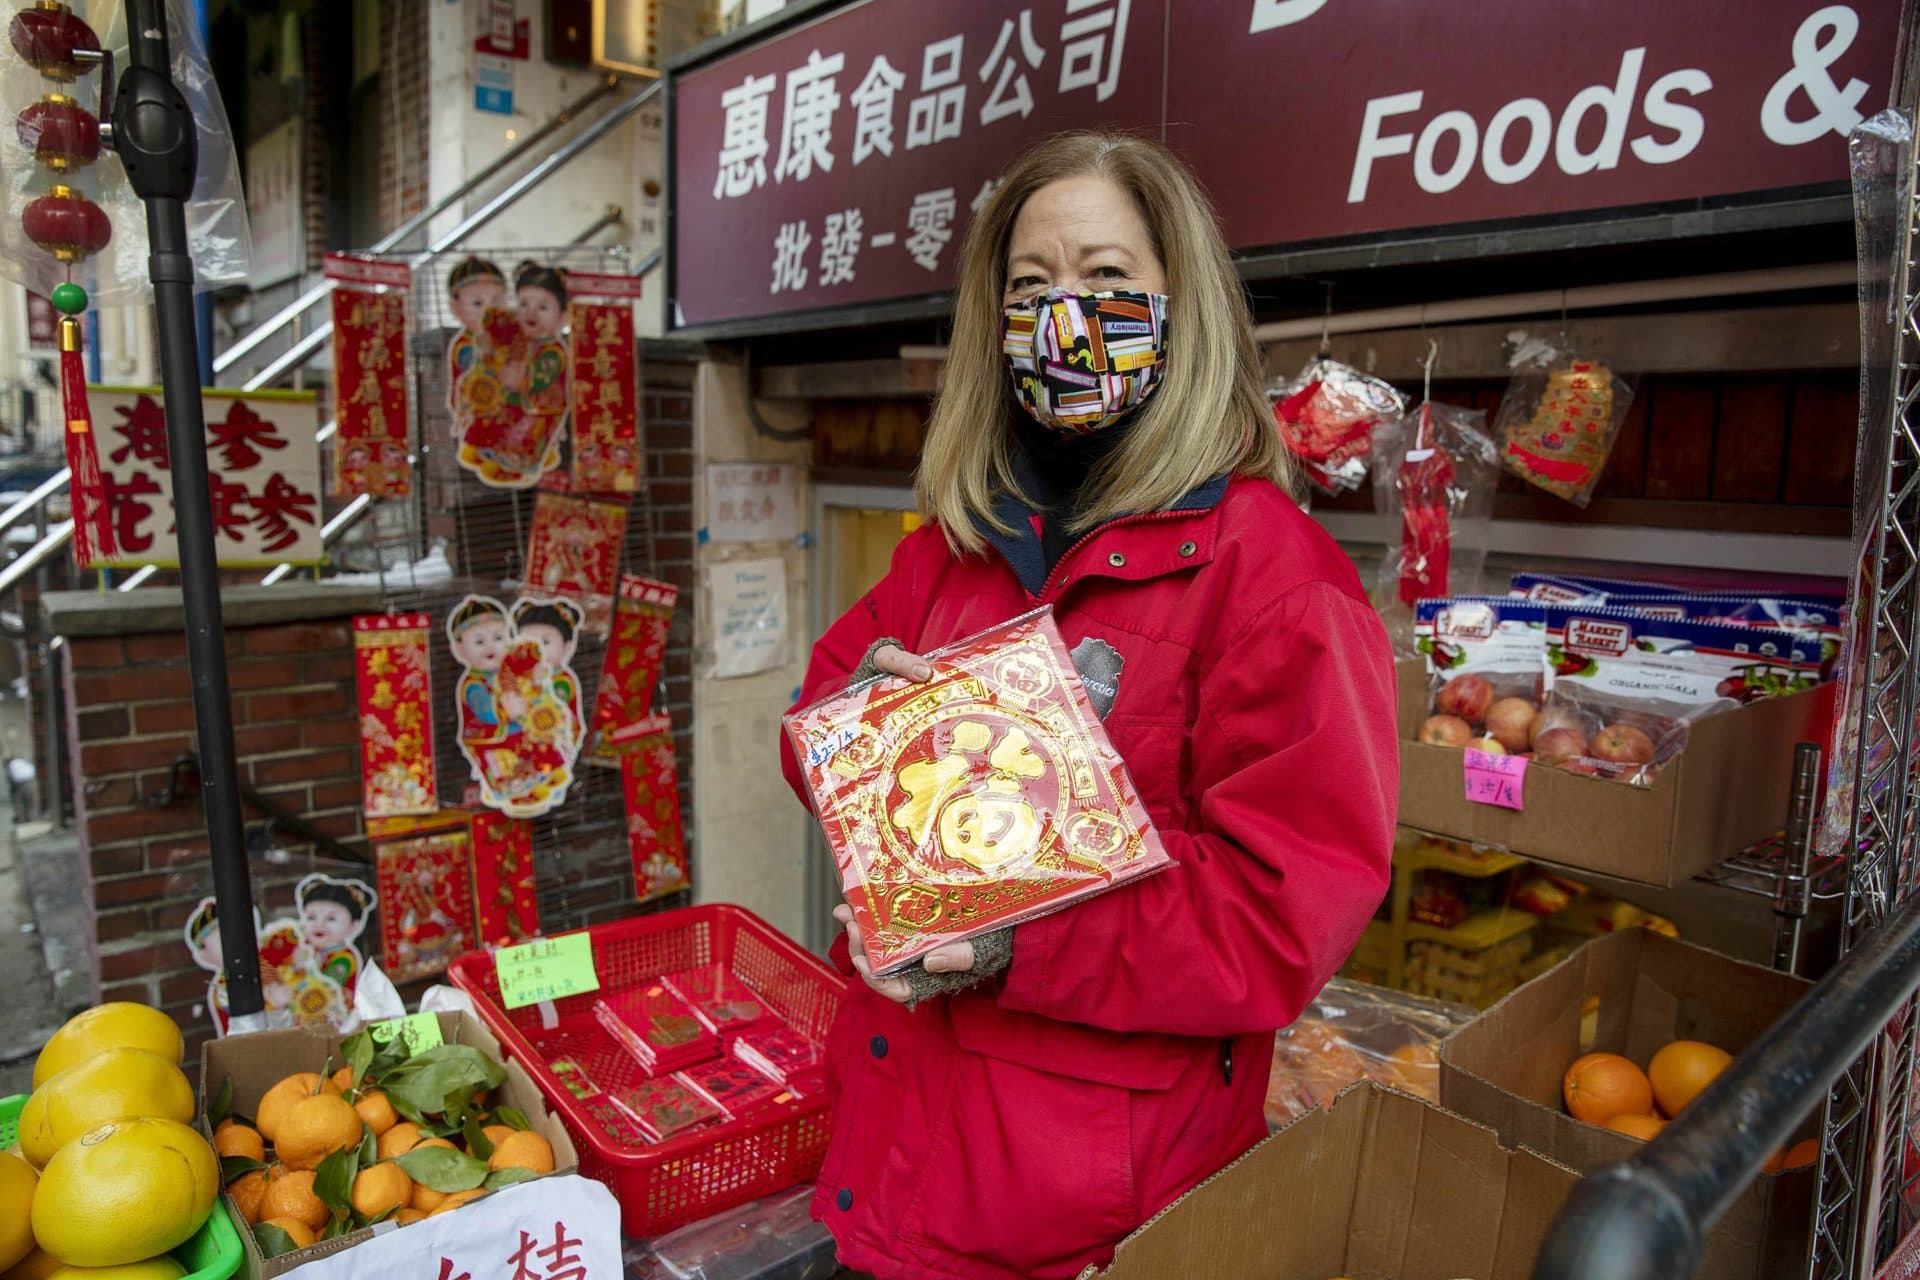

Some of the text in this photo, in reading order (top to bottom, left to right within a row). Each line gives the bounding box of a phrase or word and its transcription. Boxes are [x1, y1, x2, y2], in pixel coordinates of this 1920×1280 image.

[713, 0, 1133, 200] 惠康食品公司
[1346, 5, 1870, 204] Foods &
[770, 178, 1003, 295] 批發-零
[1111, 322, 1147, 332] chemistry
[1577, 620, 1624, 637] MARKET
